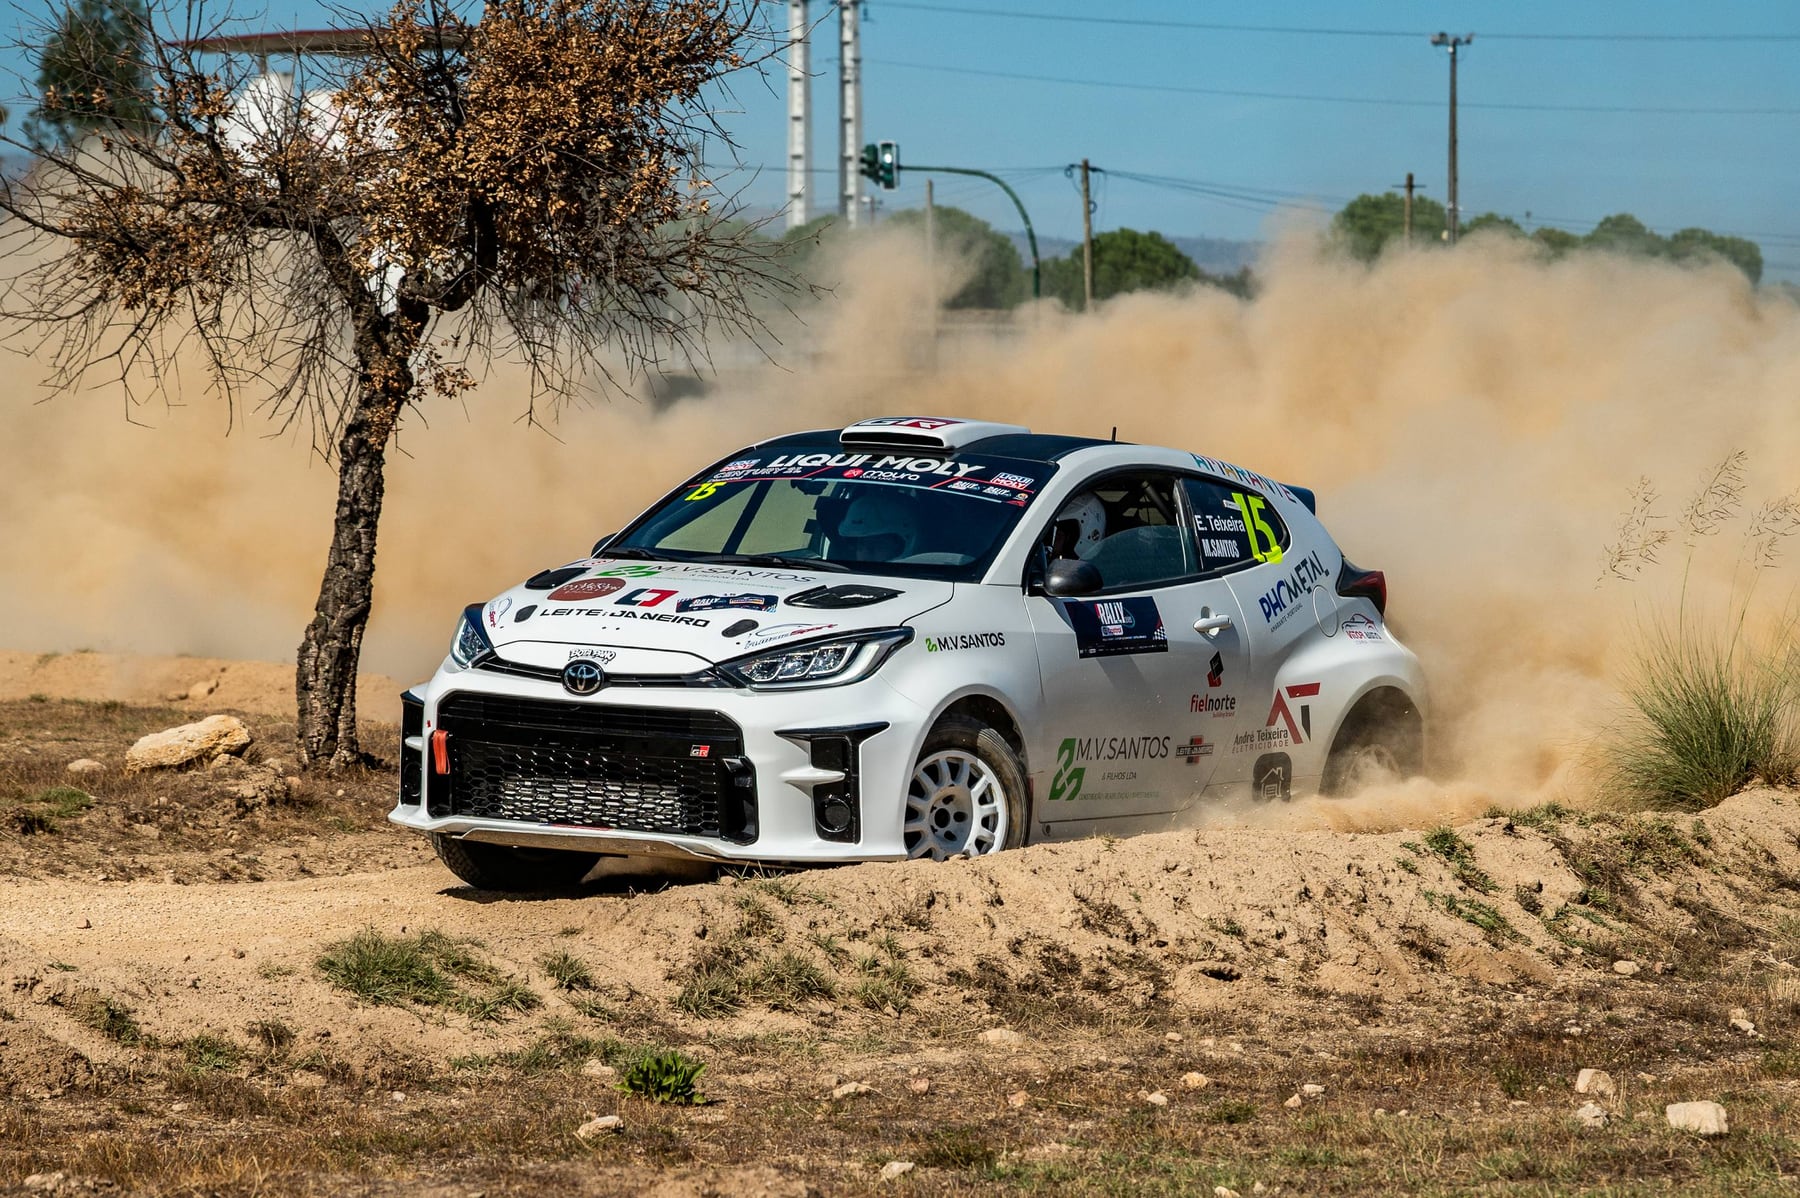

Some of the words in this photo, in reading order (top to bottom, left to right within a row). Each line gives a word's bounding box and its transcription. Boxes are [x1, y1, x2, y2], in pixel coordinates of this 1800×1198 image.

[856, 417, 950, 429] GR
[766, 453, 872, 468] LIQUI
[872, 455, 986, 477] MOLY
[862, 470, 920, 481] moura
[994, 478, 1026, 489] MOLY
[1000, 473, 1033, 484] LIQUI
[685, 481, 728, 501] 15
[1194, 514, 1207, 531] E.
[1206, 515, 1246, 533] Teixeira
[1231, 492, 1283, 564] 15
[1201, 538, 1240, 558] M.SANTOS
[540, 608, 603, 617] LEITE
[609, 610, 711, 628] JANEIRO
[1097, 601, 1126, 625] RALLY
[1190, 693, 1236, 713] fielnorte
[1232, 739, 1289, 753] ELETRICIDADE
[1234, 732, 1255, 746] André
[1256, 727, 1288, 742] Teixeira
[1106, 771, 1126, 780] FILHOS
